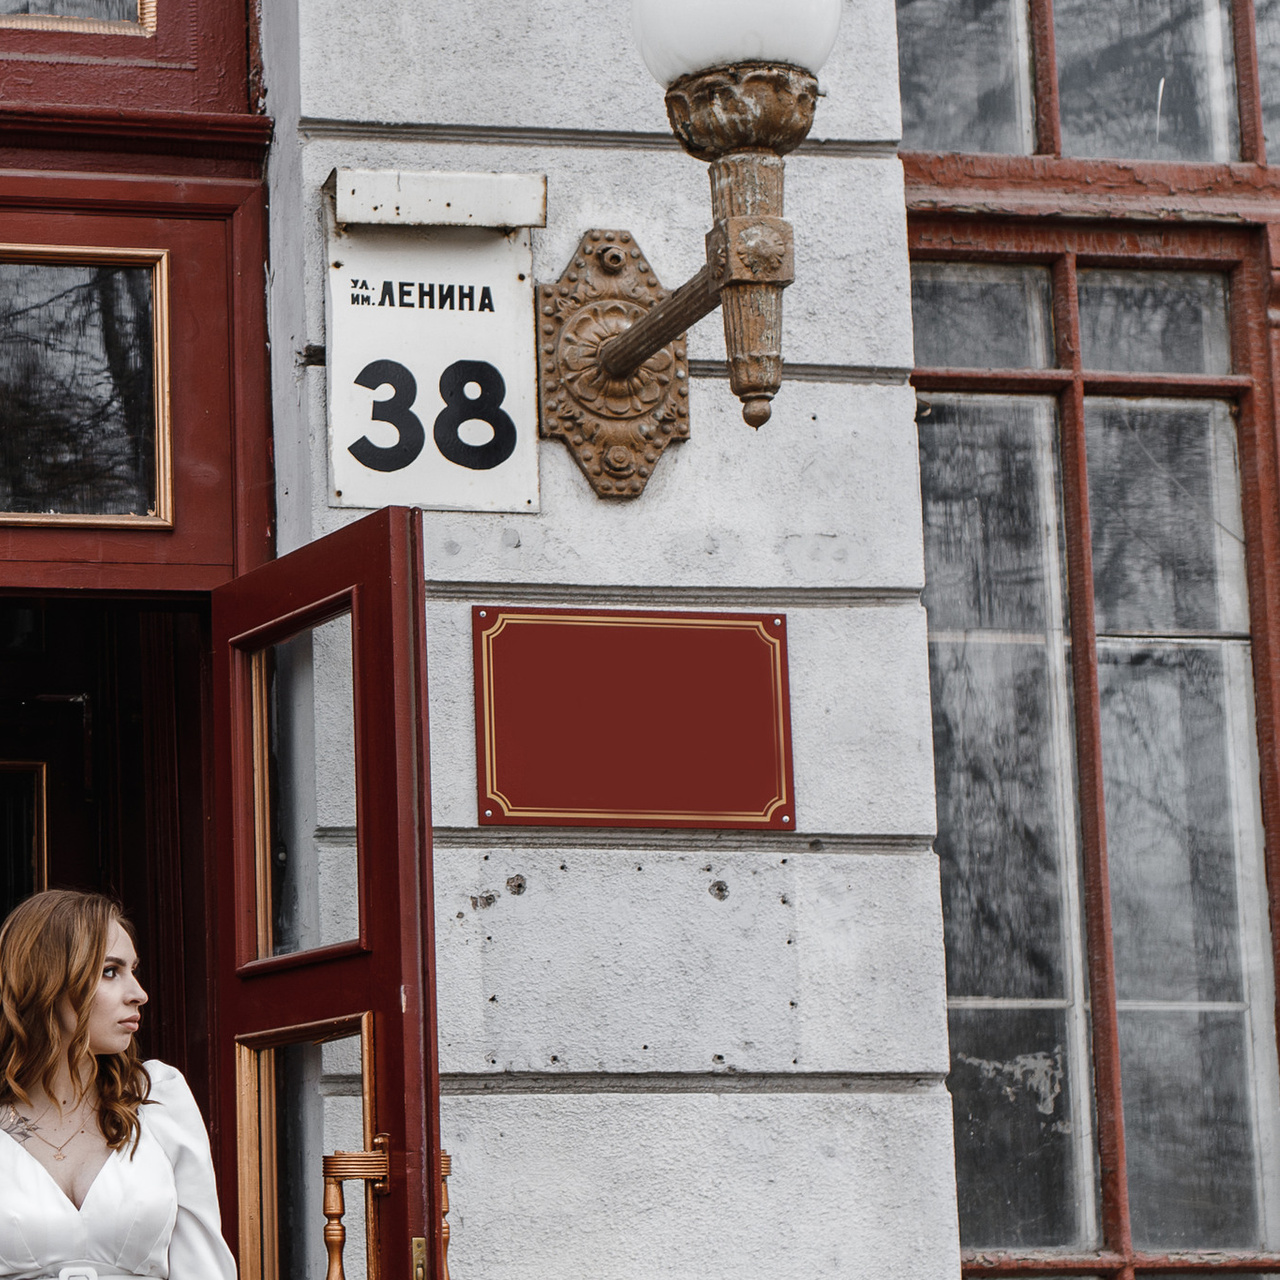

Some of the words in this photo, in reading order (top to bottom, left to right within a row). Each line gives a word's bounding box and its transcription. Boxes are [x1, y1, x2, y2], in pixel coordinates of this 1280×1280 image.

[350, 278, 376, 291] УЛ.
[350, 293, 376, 306] ИМ.
[377, 280, 496, 313] ЛЕНИНА
[347, 359, 518, 473] 38
